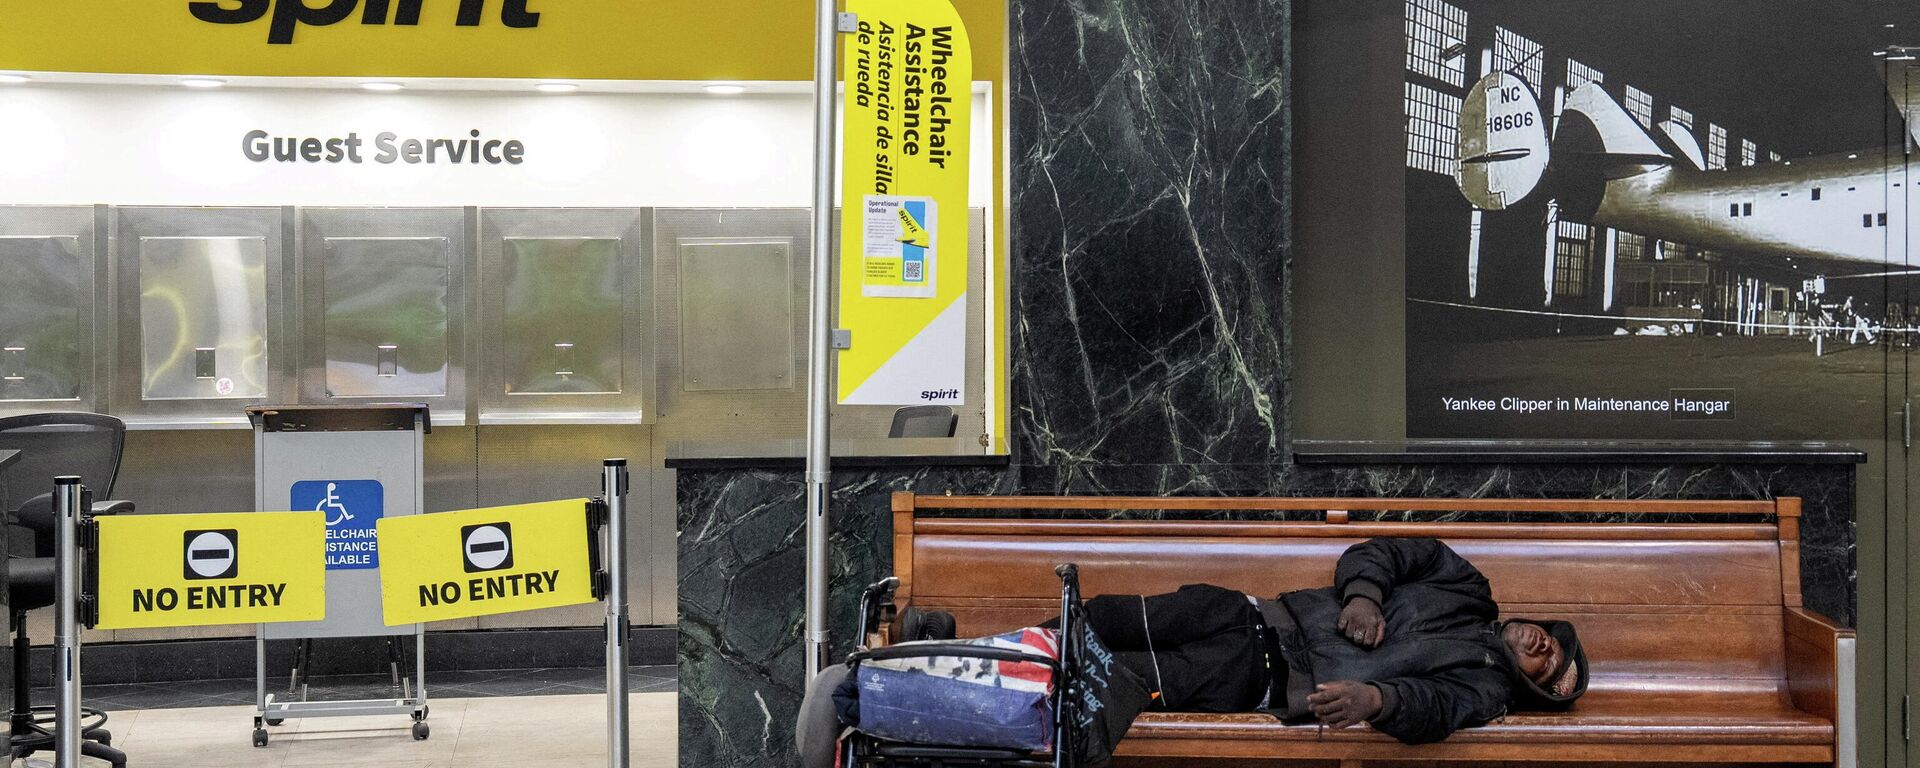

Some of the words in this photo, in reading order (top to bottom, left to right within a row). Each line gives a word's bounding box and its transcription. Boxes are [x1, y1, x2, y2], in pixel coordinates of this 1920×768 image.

[858, 20, 875, 45] de
[857, 49, 874, 108] rueda
[877, 21, 896, 122] Asistencia
[903, 23, 928, 156] Assistance
[929, 26, 953, 169] Wheelchair
[1501, 86, 1520, 104] NC
[242, 130, 363, 163] Guest
[374, 129, 525, 164] Service
[876, 126, 893, 149] de
[875, 153, 894, 196] silla
[899, 210, 917, 233] spirit
[920, 388, 959, 401] spirit
[1442, 397, 1496, 411] Yankee
[1500, 397, 1553, 414] Clipper
[1557, 397, 1570, 411] in
[1574, 397, 1670, 411] Maintenance
[1674, 398, 1730, 414] Hangar
[325, 528, 377, 539] ELCHAIR
[325, 541, 377, 552] ISTANCE
[325, 554, 371, 565] ILABLE
[132, 588, 179, 612] NO
[187, 583, 287, 610] ENTRY
[419, 581, 461, 607] NO
[468, 570, 560, 602] ENTRY
